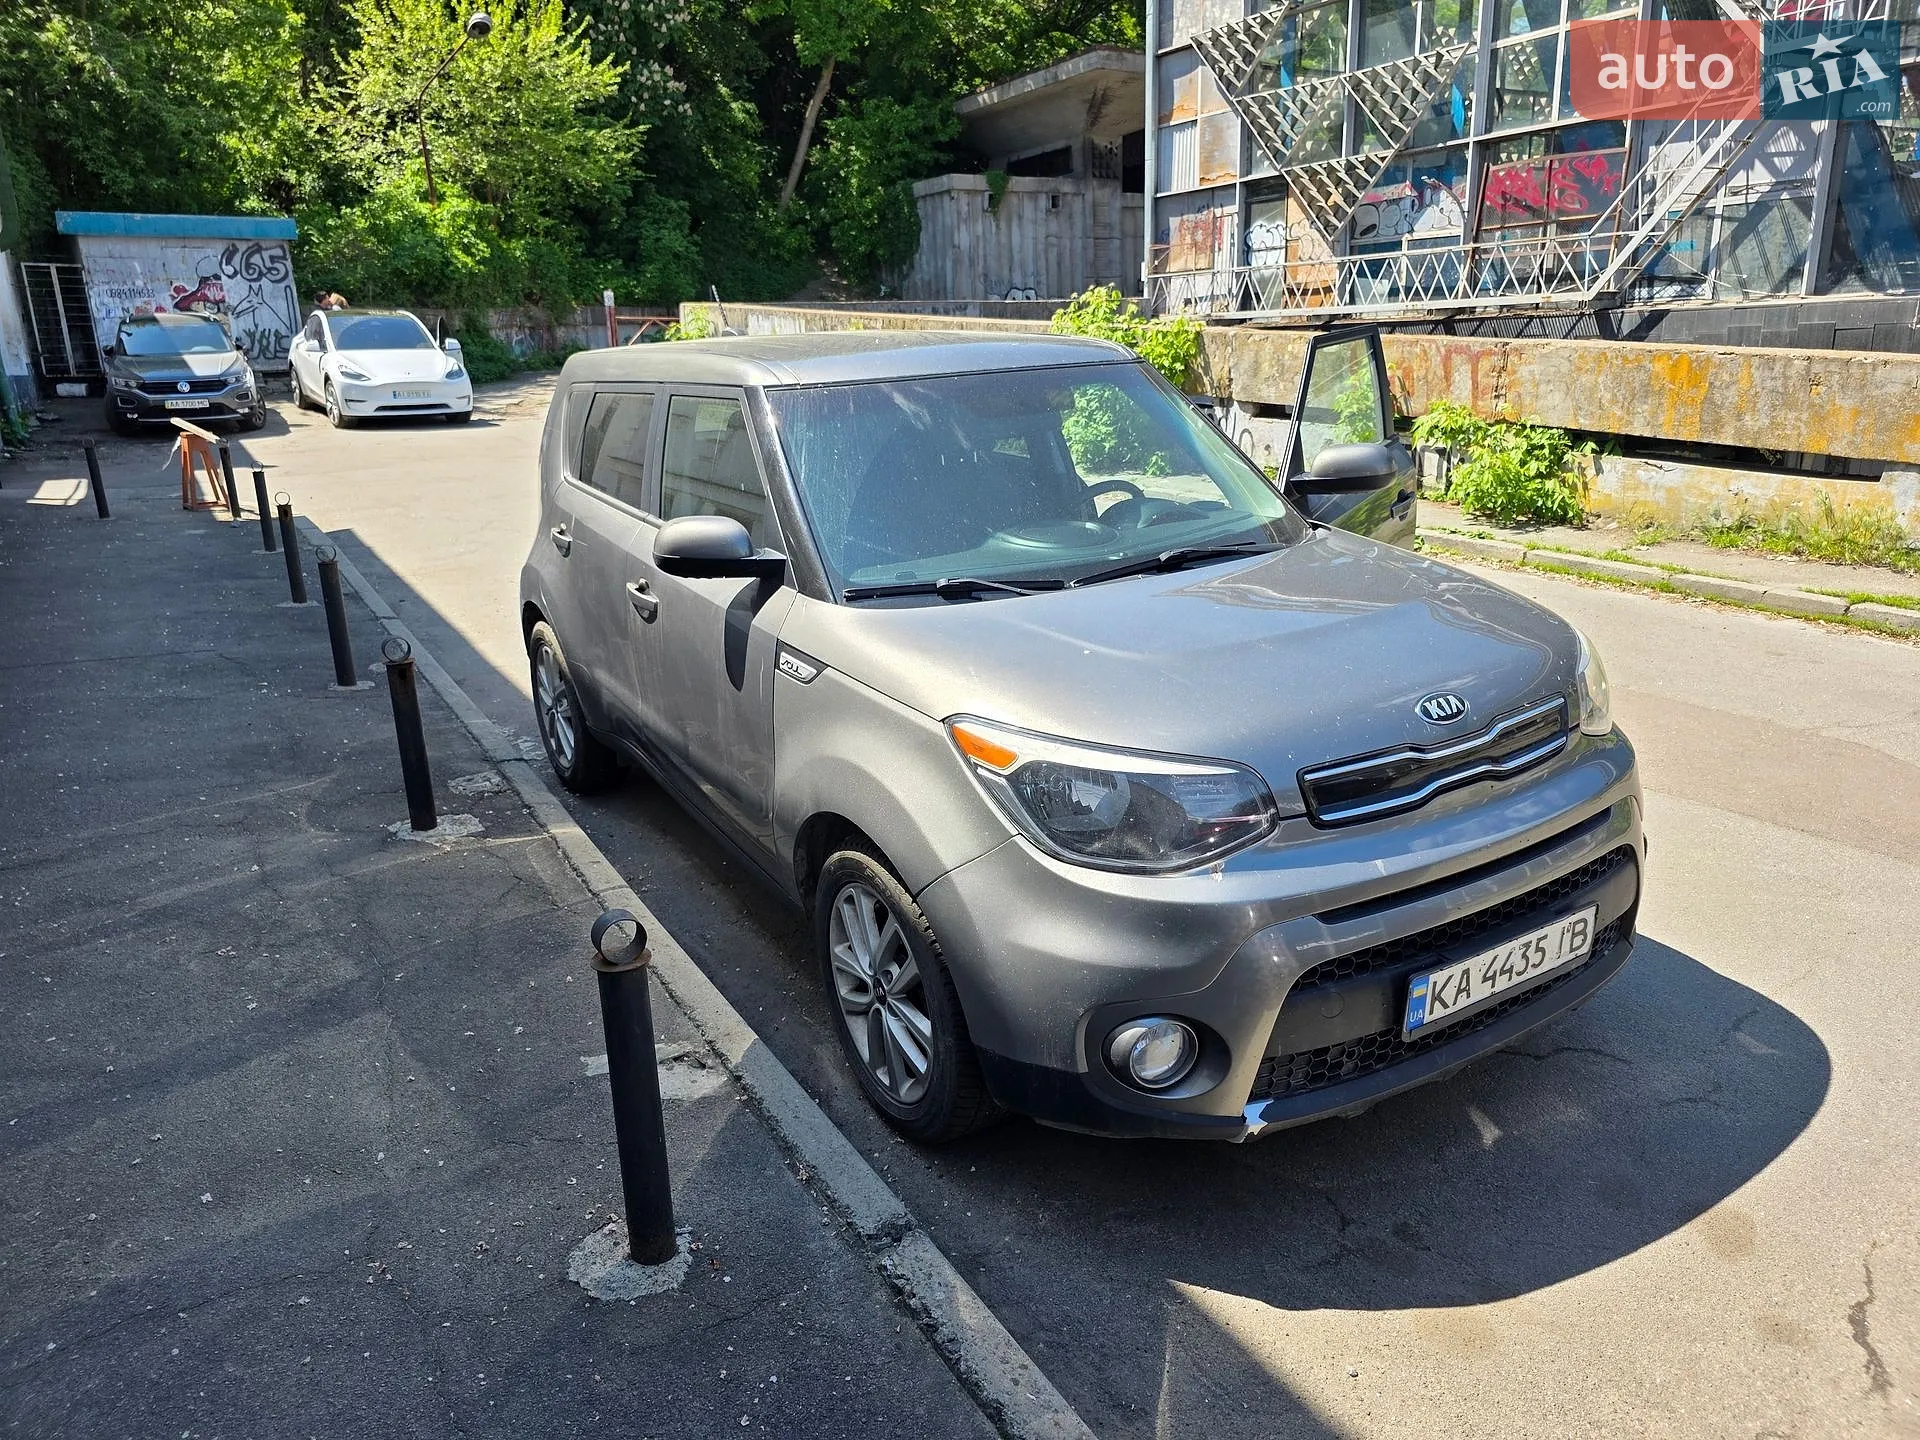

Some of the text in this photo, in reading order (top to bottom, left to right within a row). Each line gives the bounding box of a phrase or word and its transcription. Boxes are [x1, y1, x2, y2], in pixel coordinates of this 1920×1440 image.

[1423, 695, 1465, 719] KIA
[1428, 968, 1471, 1016] KA
[1481, 934, 1549, 989] 4435
[1410, 1009, 1423, 1022] UA
